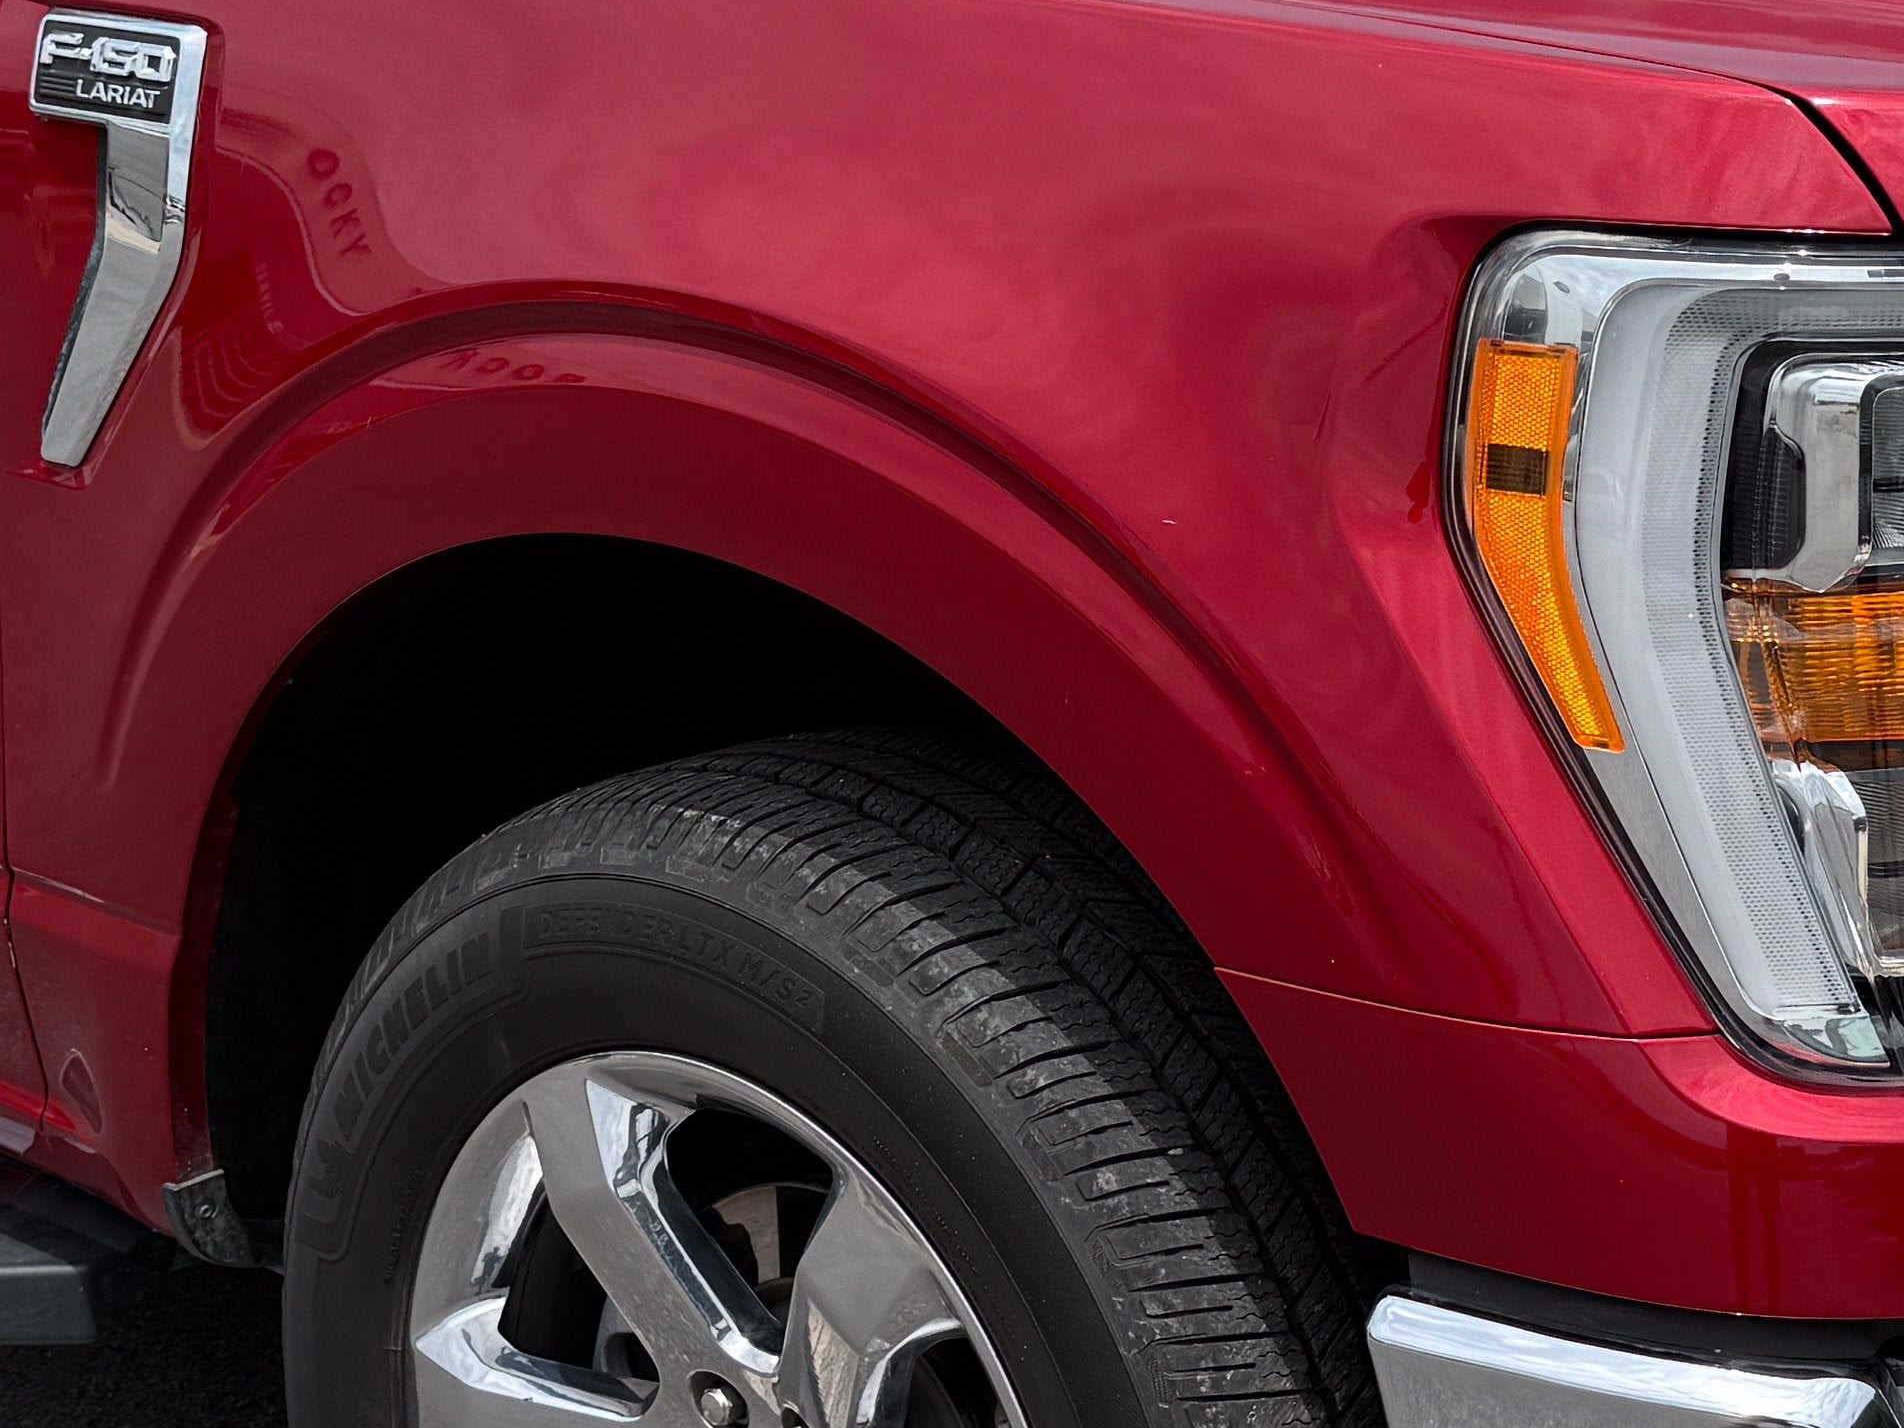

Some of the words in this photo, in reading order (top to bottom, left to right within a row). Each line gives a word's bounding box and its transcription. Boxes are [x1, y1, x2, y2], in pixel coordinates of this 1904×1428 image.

[39, 31, 177, 83] F-150
[76, 79, 161, 109] LARIAT
[538, 907, 676, 947] DEFENDER
[679, 924, 731, 968] LTX
[334, 933, 492, 1137] MICHELIN
